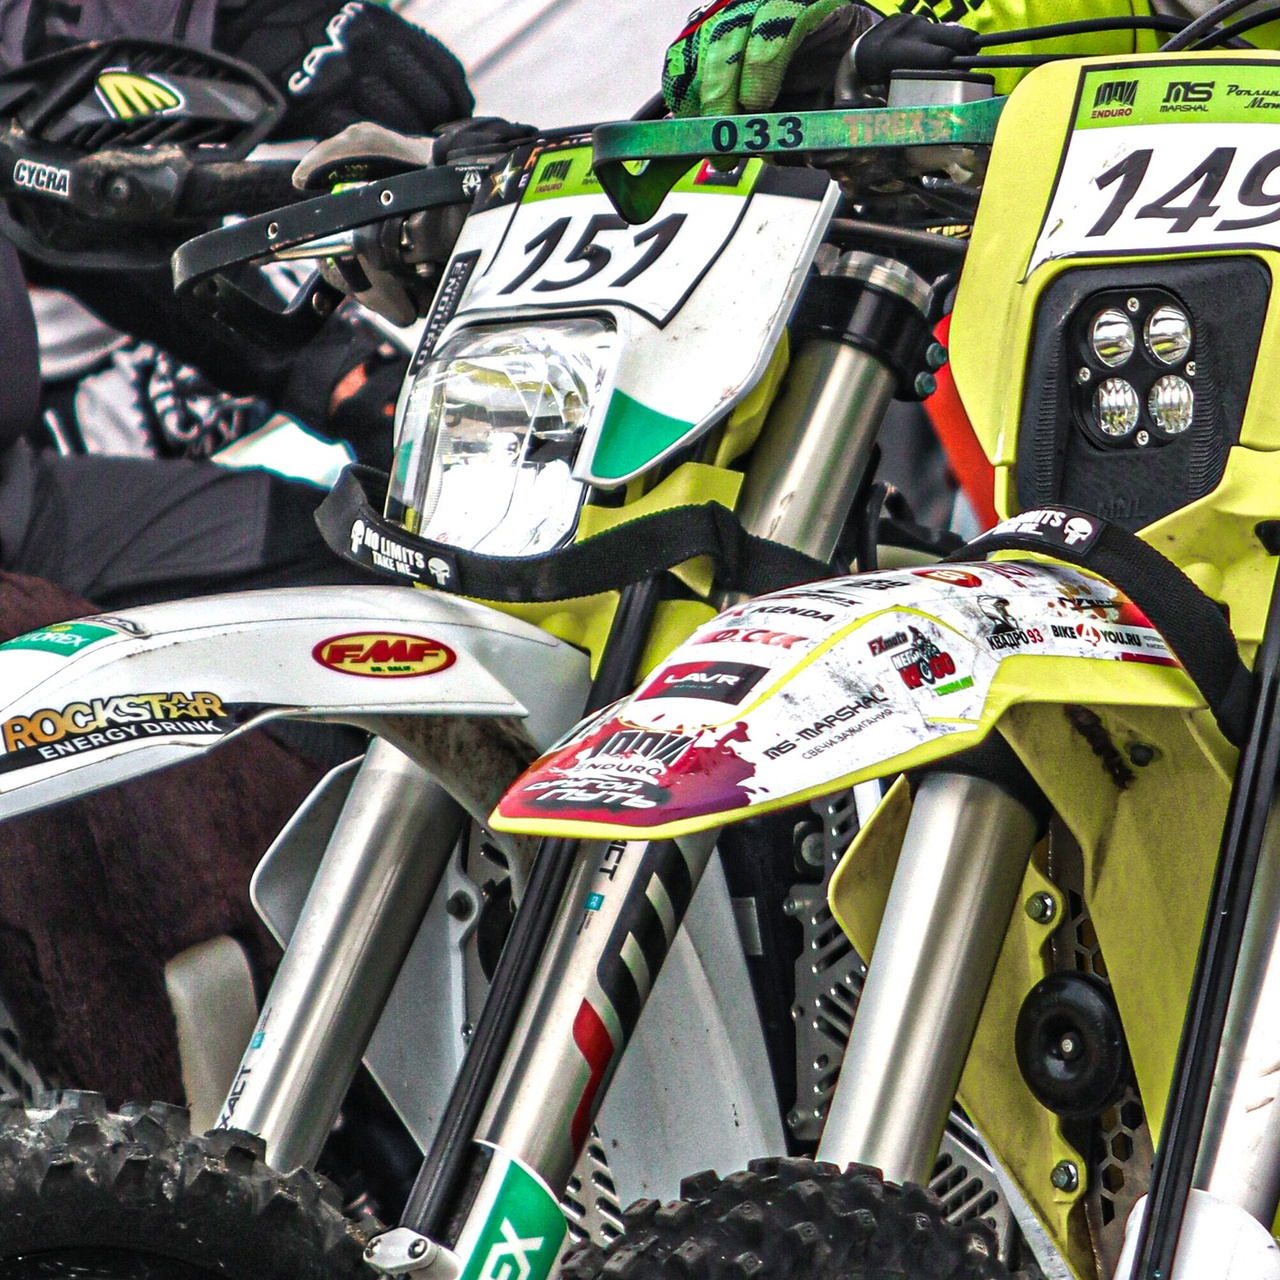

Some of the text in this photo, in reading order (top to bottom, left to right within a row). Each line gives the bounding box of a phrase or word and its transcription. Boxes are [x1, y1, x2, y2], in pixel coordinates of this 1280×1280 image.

[1091, 108, 1133, 120] ENDURO
[712, 117, 803, 152] 033
[14, 159, 70, 196] CYCRA
[498, 212, 688, 295] 151
[364, 527, 425, 569] NO LIMITS
[372, 551, 395, 571] TAKE
[752, 605, 835, 622] KENDA
[326, 640, 441, 664] FMF
[664, 672, 740, 686] LAVR
[1, 691, 228, 752] ROCKSTAR
[38, 719, 223, 760] ENERGY DRINK
[801, 736, 836, 760] СВЕЧИ
[574, 762, 663, 776] ENDURO
[536, 788, 657, 809] ПУТЬ
